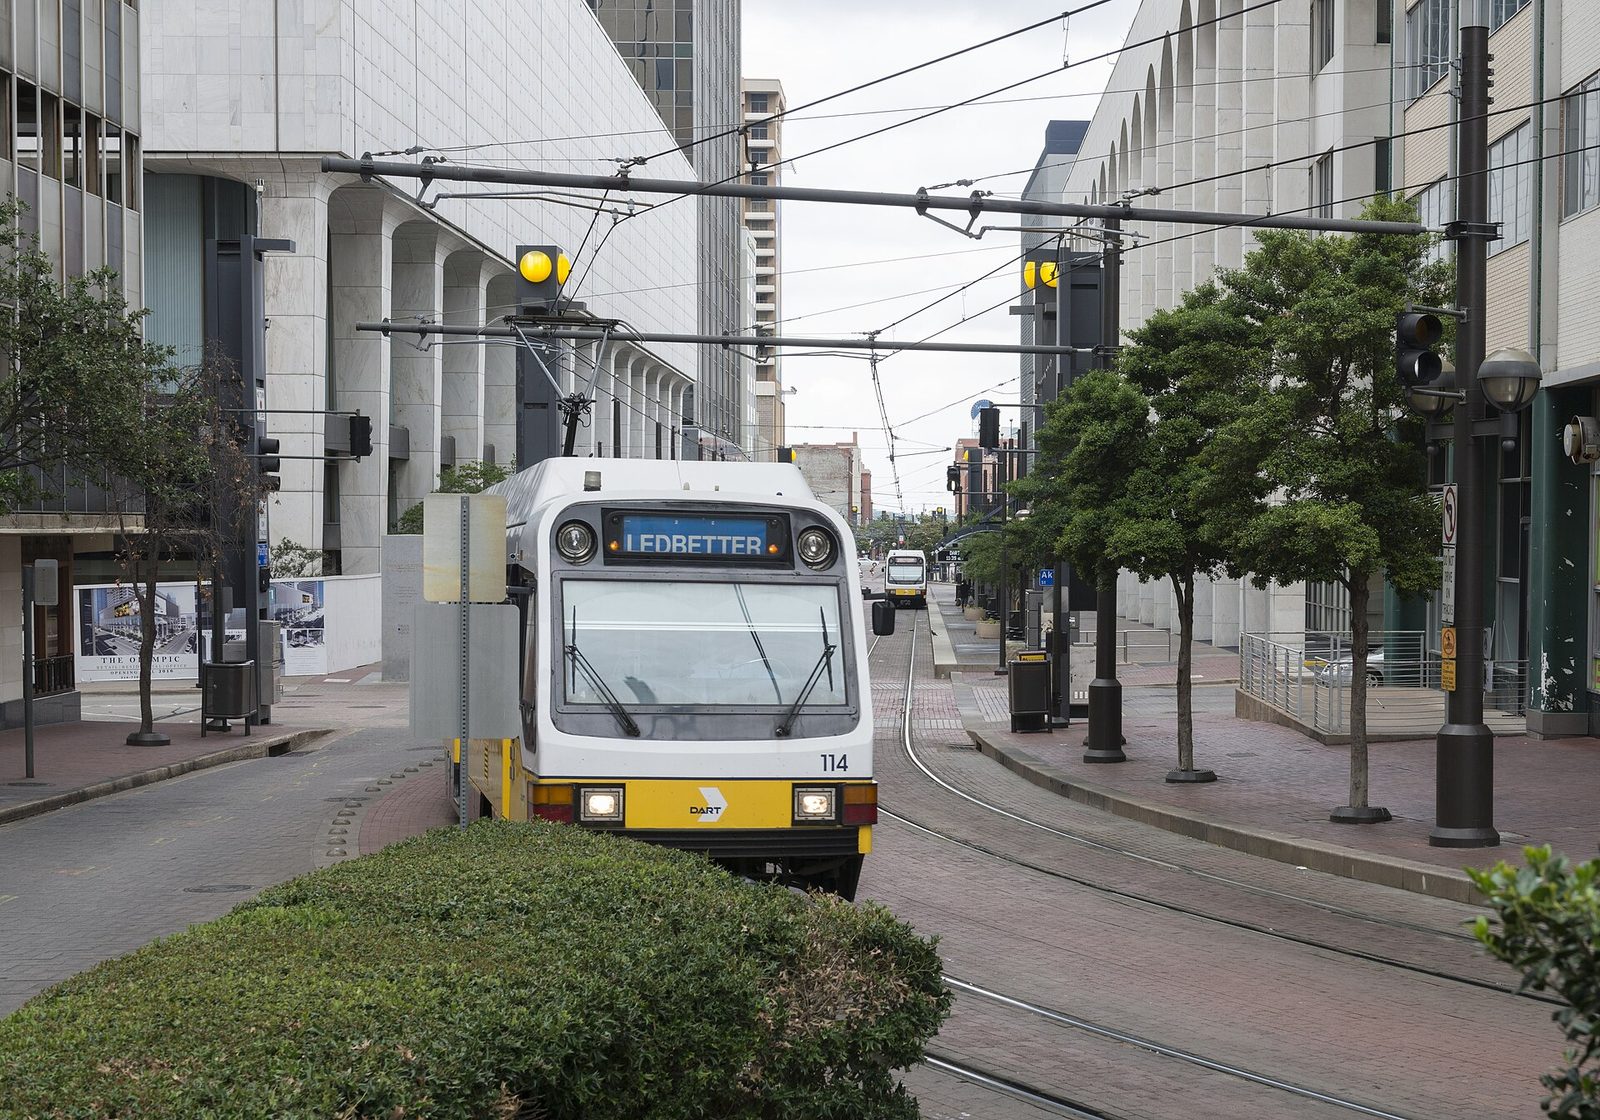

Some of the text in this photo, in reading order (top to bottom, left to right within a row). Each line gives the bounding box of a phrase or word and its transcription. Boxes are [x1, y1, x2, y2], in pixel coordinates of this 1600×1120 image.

[626, 533, 762, 555] LEDBETTER
[820, 754, 849, 771] 114
[689, 806, 722, 815] DART
